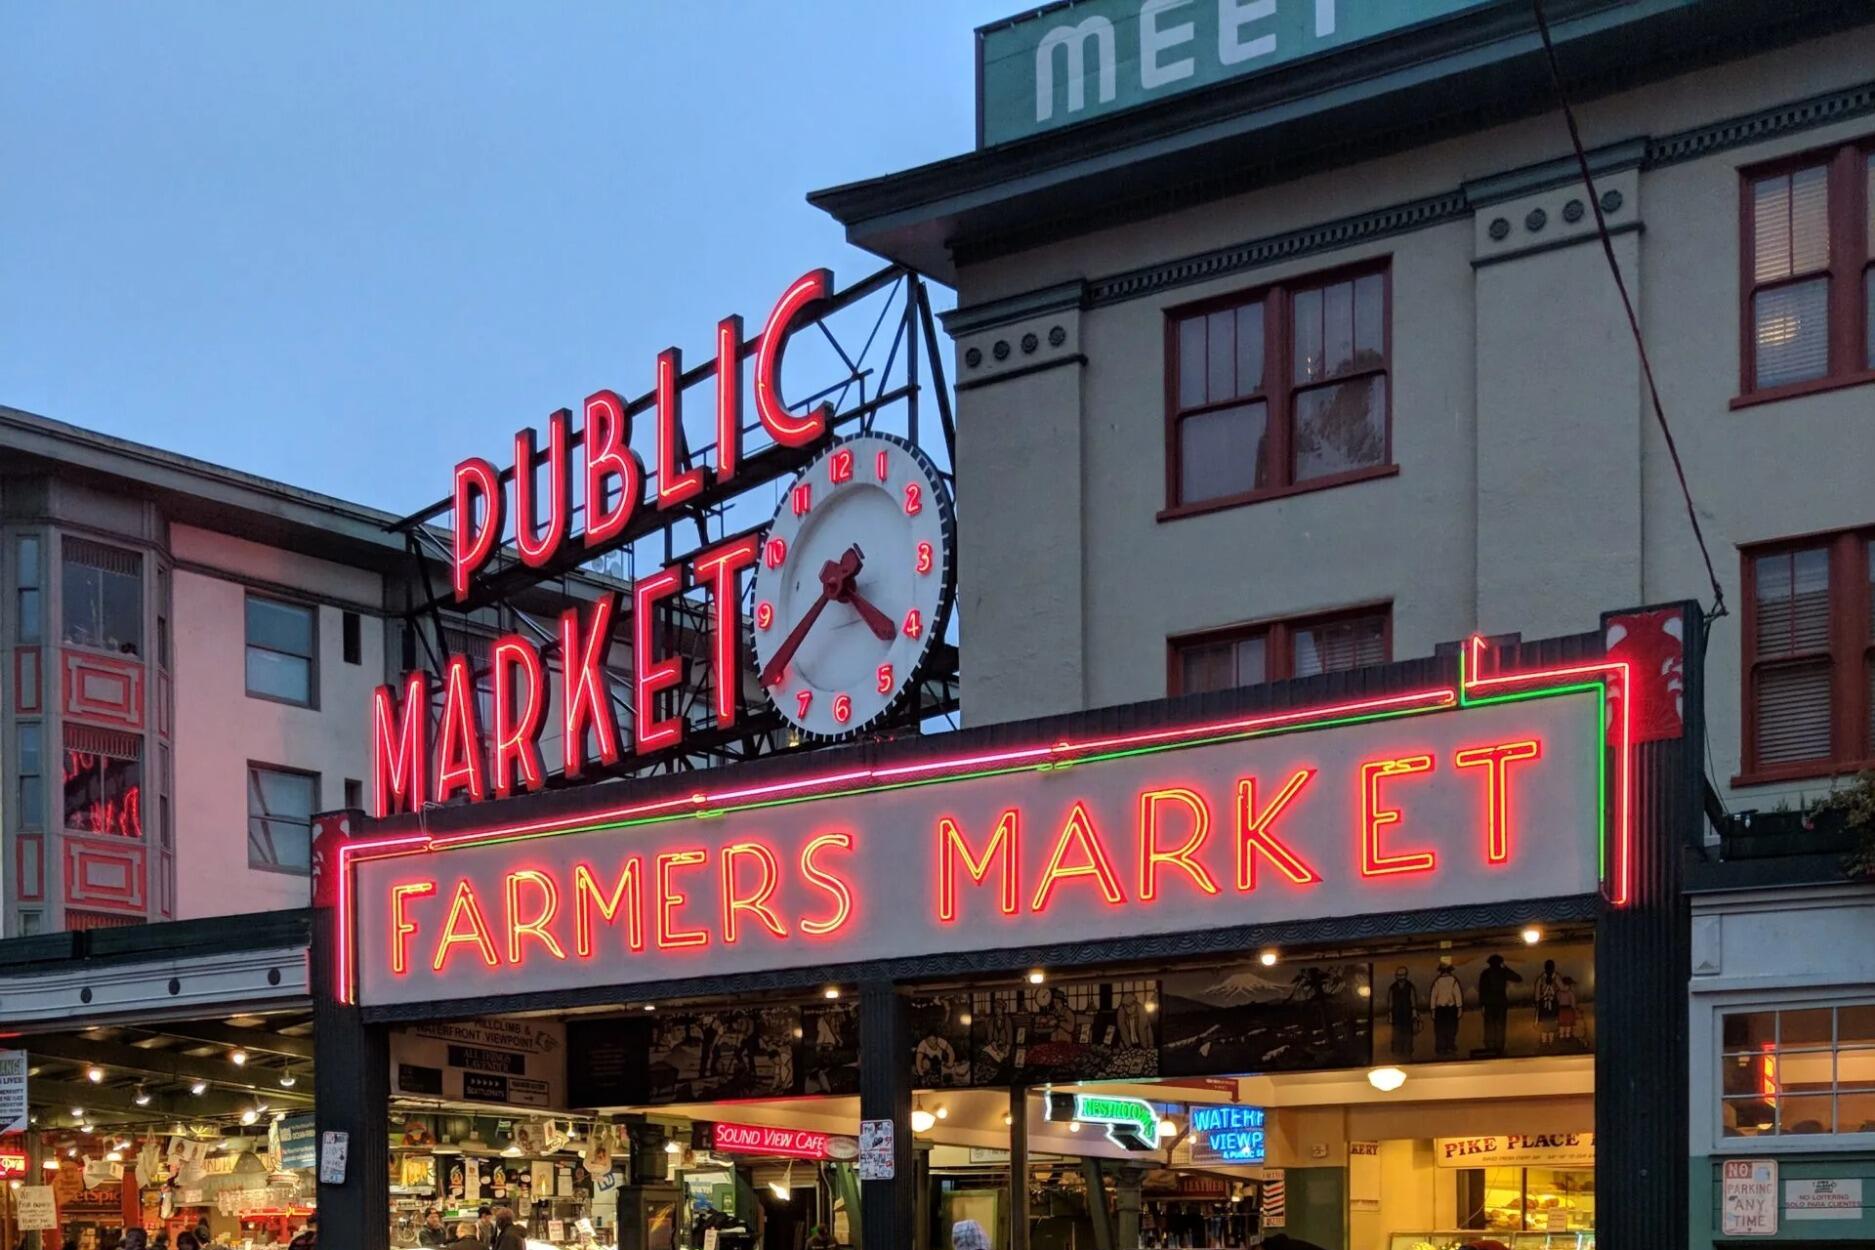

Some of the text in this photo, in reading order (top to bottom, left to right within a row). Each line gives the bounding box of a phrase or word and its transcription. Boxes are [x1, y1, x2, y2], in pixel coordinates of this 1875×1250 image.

[453, 267, 834, 601] PUBLIC
[829, 450, 853, 483] 12
[876, 450, 888, 481] 1
[792, 484, 812, 516] 11
[905, 484, 922, 516] 2
[765, 539, 786, 569] 10
[916, 542, 933, 575] 3
[757, 603, 773, 631] 9
[903, 608, 921, 639] 4
[371, 532, 759, 819] MARKET
[877, 663, 893, 694] 5
[796, 690, 813, 720] 7
[833, 695, 851, 724] 6
[391, 739, 1542, 974] FARMERS MARKET
[484, 1033, 534, 1048] VIEWPOINT
[716, 1124, 760, 1145] SOUND
[763, 1128, 793, 1148] VIEW
[795, 1132, 825, 1150] CAFE
[1444, 1137, 1498, 1158] PIKE
[1506, 1132, 1580, 1150] PLACE
[1728, 1162, 1749, 1177] NO
[1734, 1198, 1765, 1211] ANY
[1734, 1215, 1768, 1227] TIME
